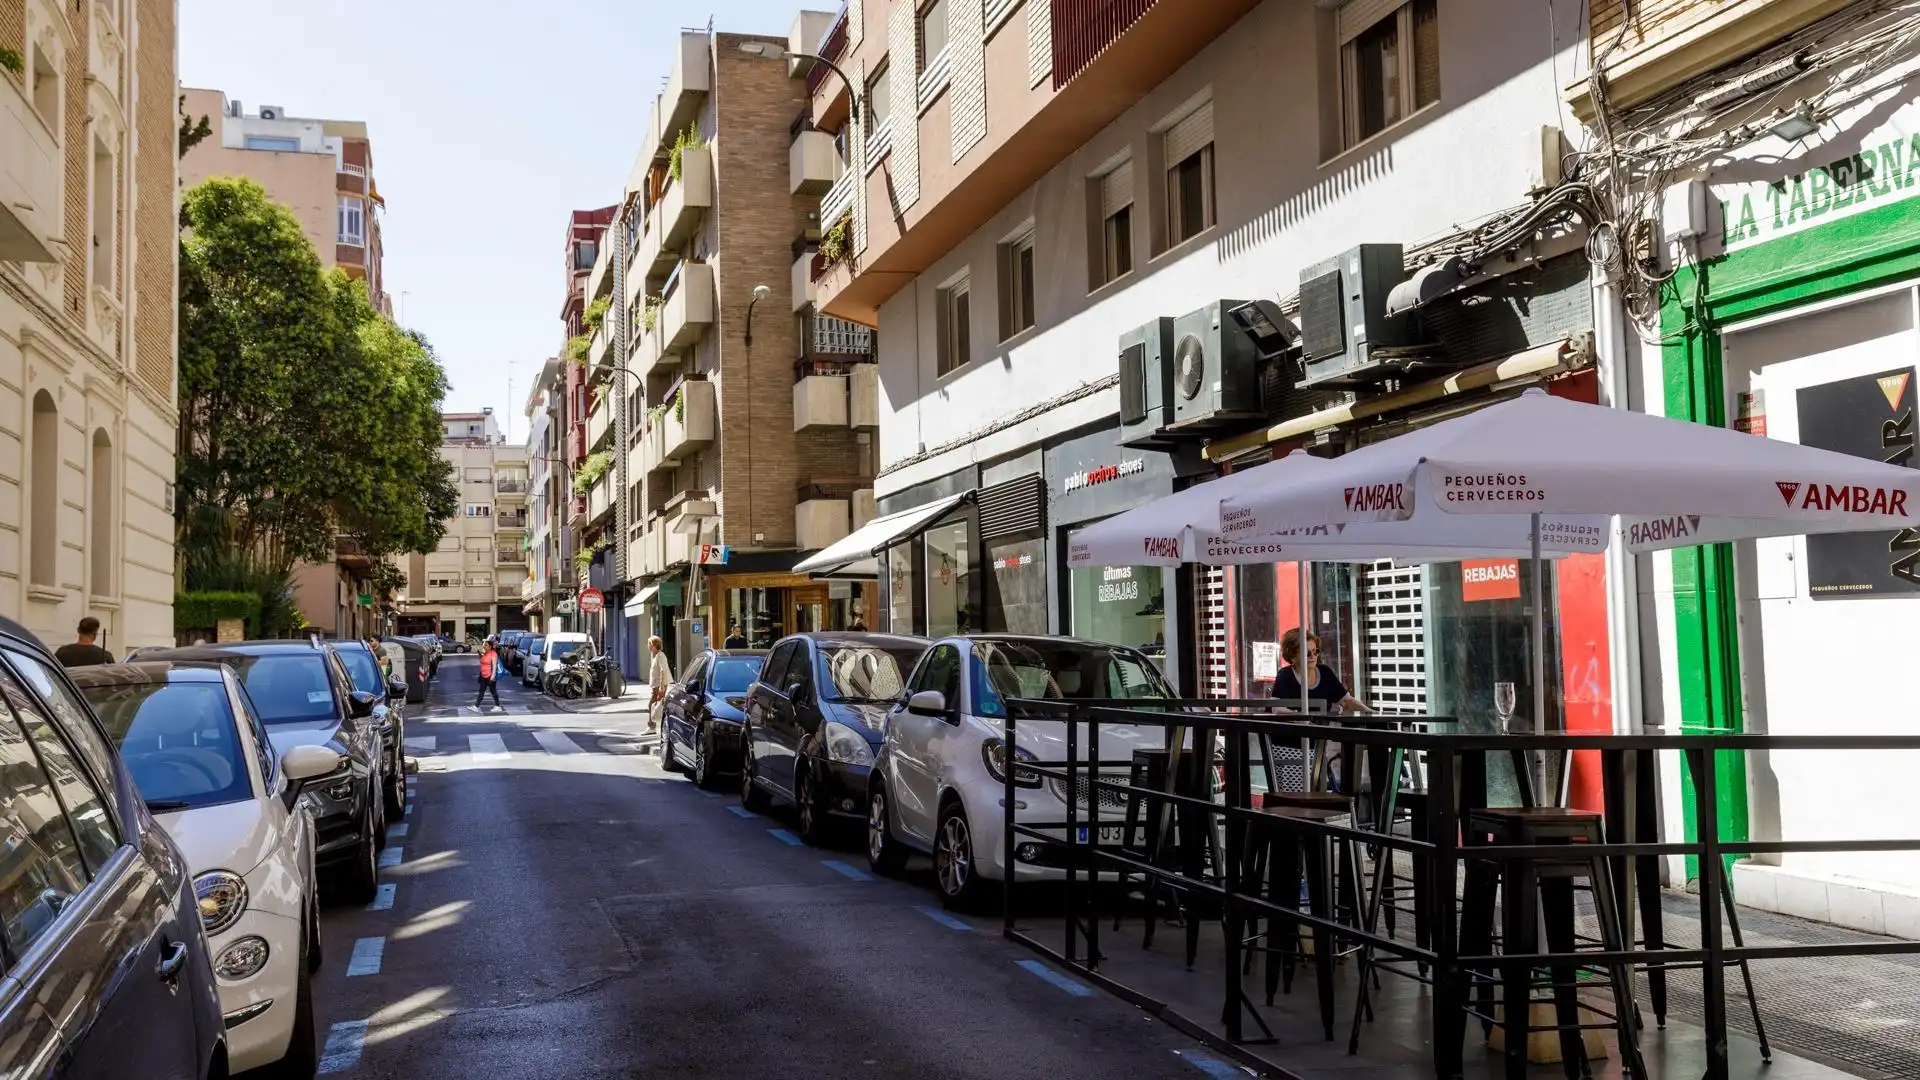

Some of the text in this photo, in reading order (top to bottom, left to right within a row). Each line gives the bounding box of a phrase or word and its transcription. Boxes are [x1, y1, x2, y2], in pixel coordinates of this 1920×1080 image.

[1721, 193, 1759, 246] LA
[1445, 473, 1526, 487] PEQUEÑOS
[1354, 483, 1405, 512] AMBAR
[1446, 490, 1545, 502] CERVECEROS
[1801, 483, 1909, 517] AMBAR
[1150, 537, 1179, 558] AMBAR
[1208, 544, 1282, 556] CERVECEROS
[1103, 565, 1132, 581] últimas
[1464, 564, 1517, 583] REBAJAS
[1098, 580, 1138, 602] REBAJAS
